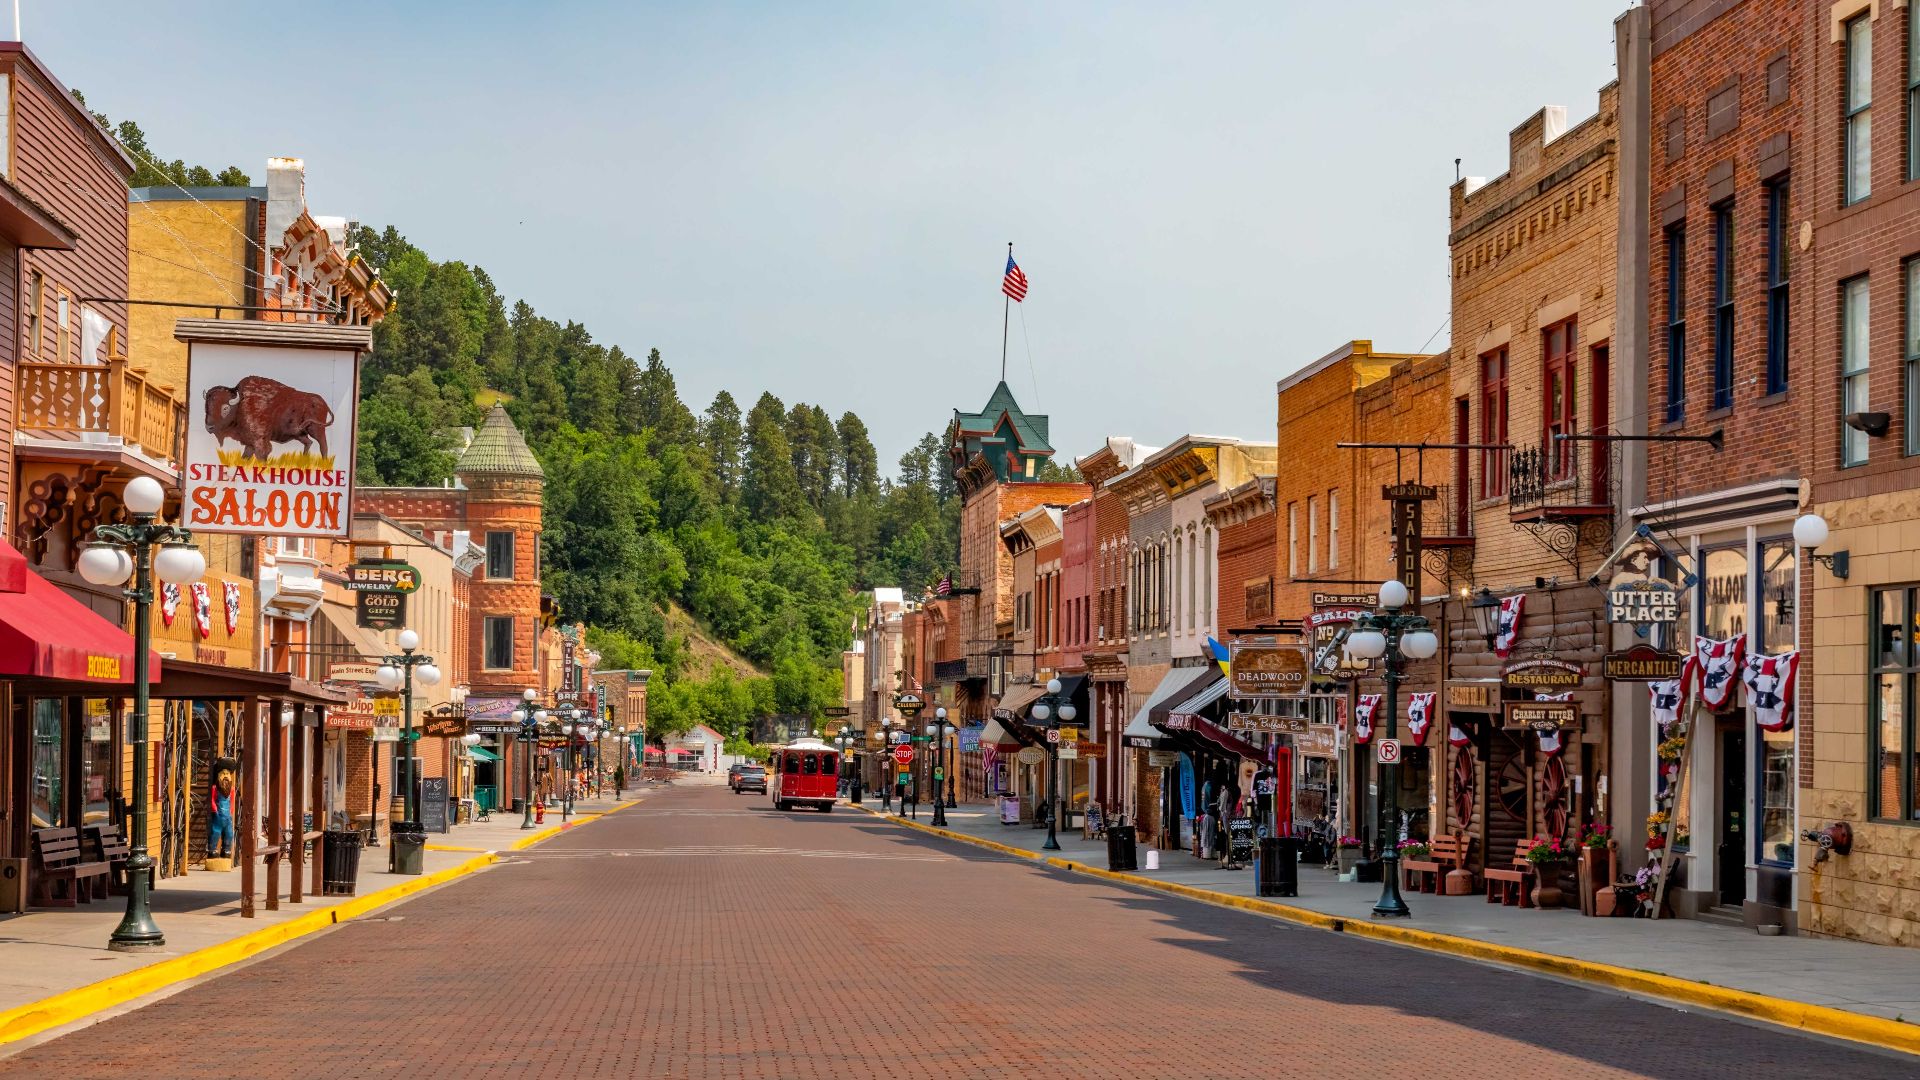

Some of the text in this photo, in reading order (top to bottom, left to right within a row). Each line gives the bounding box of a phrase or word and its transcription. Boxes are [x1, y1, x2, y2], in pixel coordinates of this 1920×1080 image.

[190, 463, 347, 487] STEAKHOUSE
[191, 486, 343, 531] SALOON
[1405, 503, 1415, 605] SALOON
[354, 568, 412, 583] BERG
[348, 582, 392, 590] JEWELRY
[365, 597, 399, 607] GOLD
[1314, 594, 1377, 605] OLD STYLE
[1611, 591, 1677, 606] UTTER
[1612, 606, 1677, 622] PLACE
[88, 655, 121, 679] BODEGA
[345, 666, 364, 674] Street
[1607, 661, 1679, 676] MERCANTILE
[1238, 672, 1302, 681] DEADWOOD
[1508, 673, 1580, 685] RESTAURANT
[557, 693, 579, 701] BAR
[1512, 709, 1575, 721] CHARLEY UTTER
[1232, 715, 1305, 731] & Tipsy Buffalo Bar
